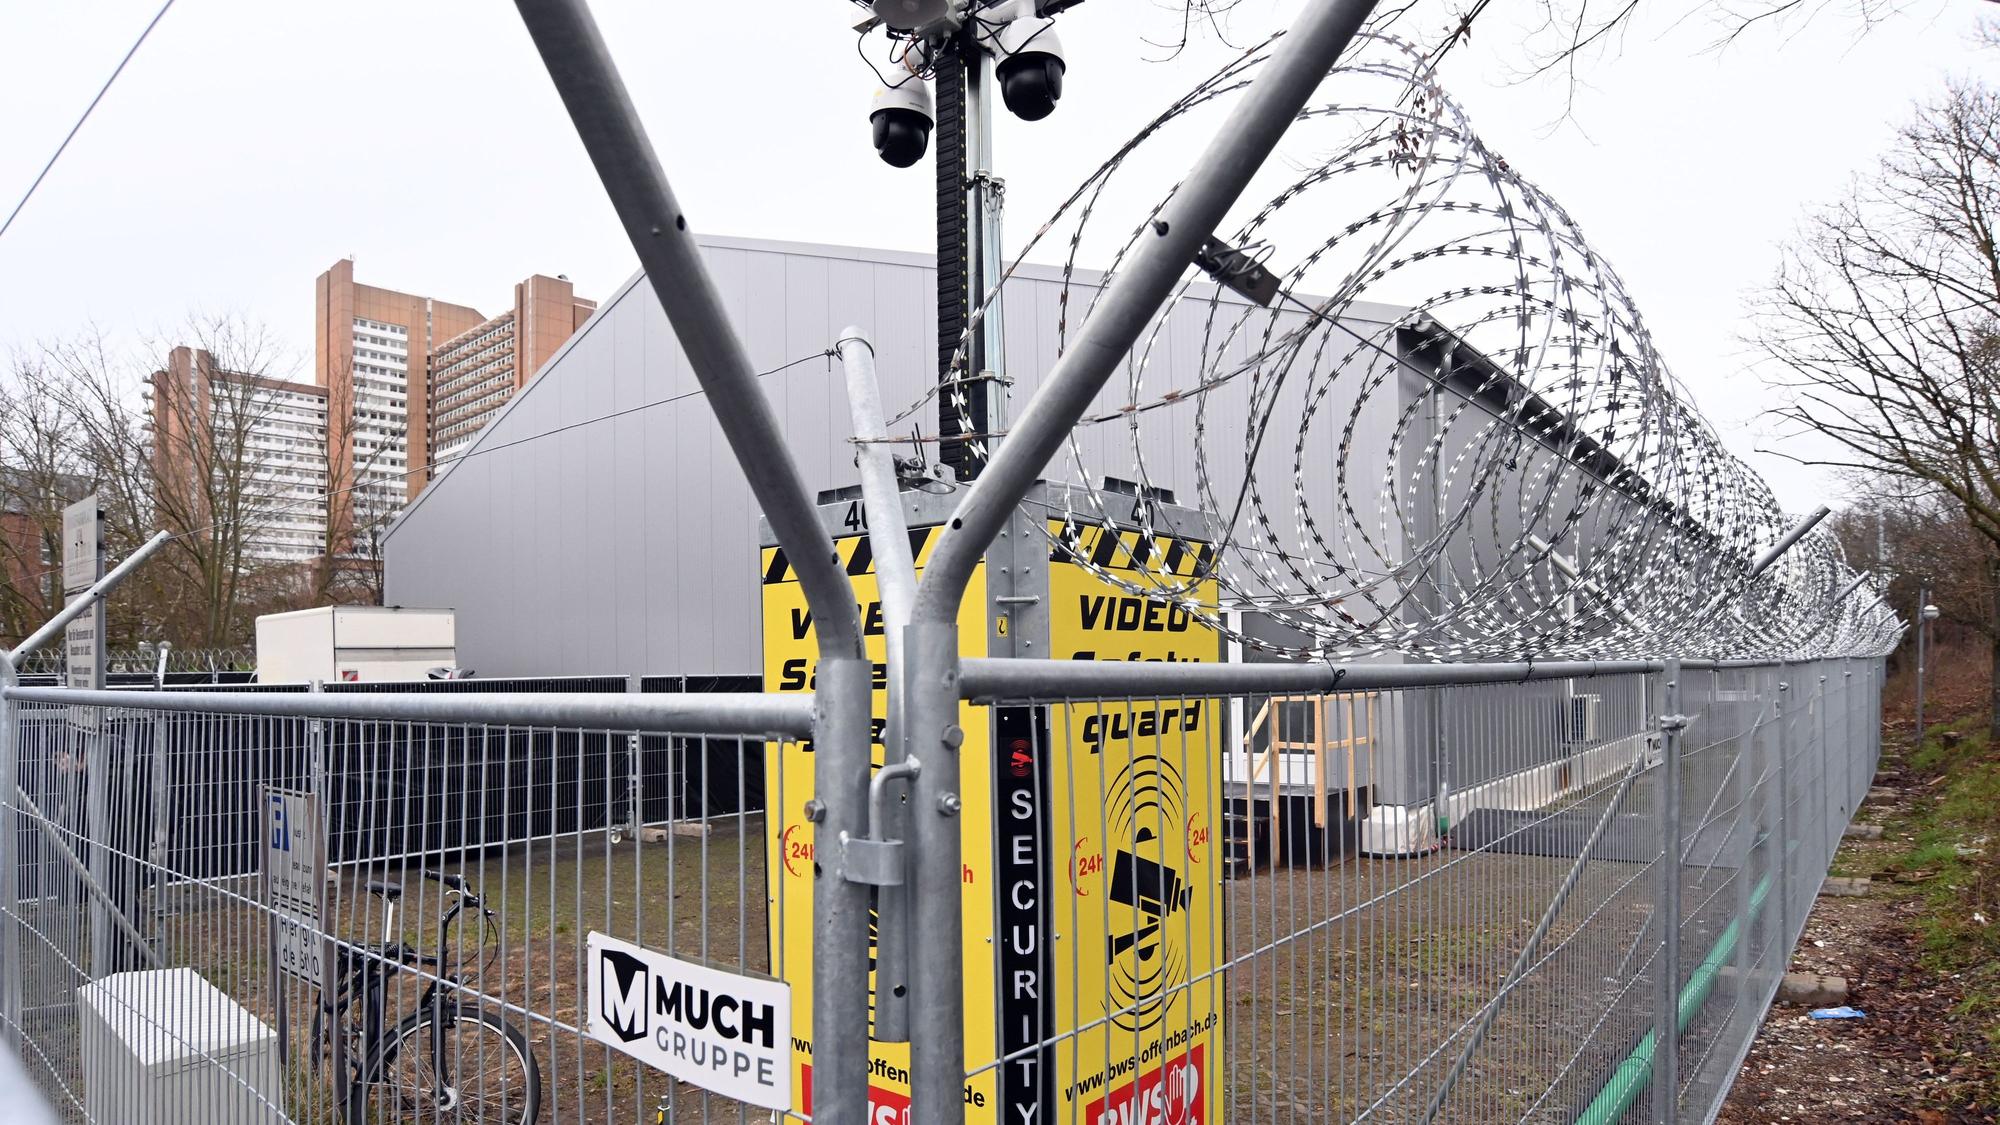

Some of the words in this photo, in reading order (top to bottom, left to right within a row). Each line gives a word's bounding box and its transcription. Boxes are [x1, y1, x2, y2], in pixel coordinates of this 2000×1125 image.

[844, 500, 868, 531] 4
[1131, 499, 1154, 528] 40
[1082, 700, 1201, 754] guard
[1079, 853, 1103, 876] 24h
[281, 917, 298, 938] Her
[1011, 788, 1039, 1125] SECURITY
[656, 975, 774, 1049] MUCH
[655, 1025, 774, 1087] GRUPPE
